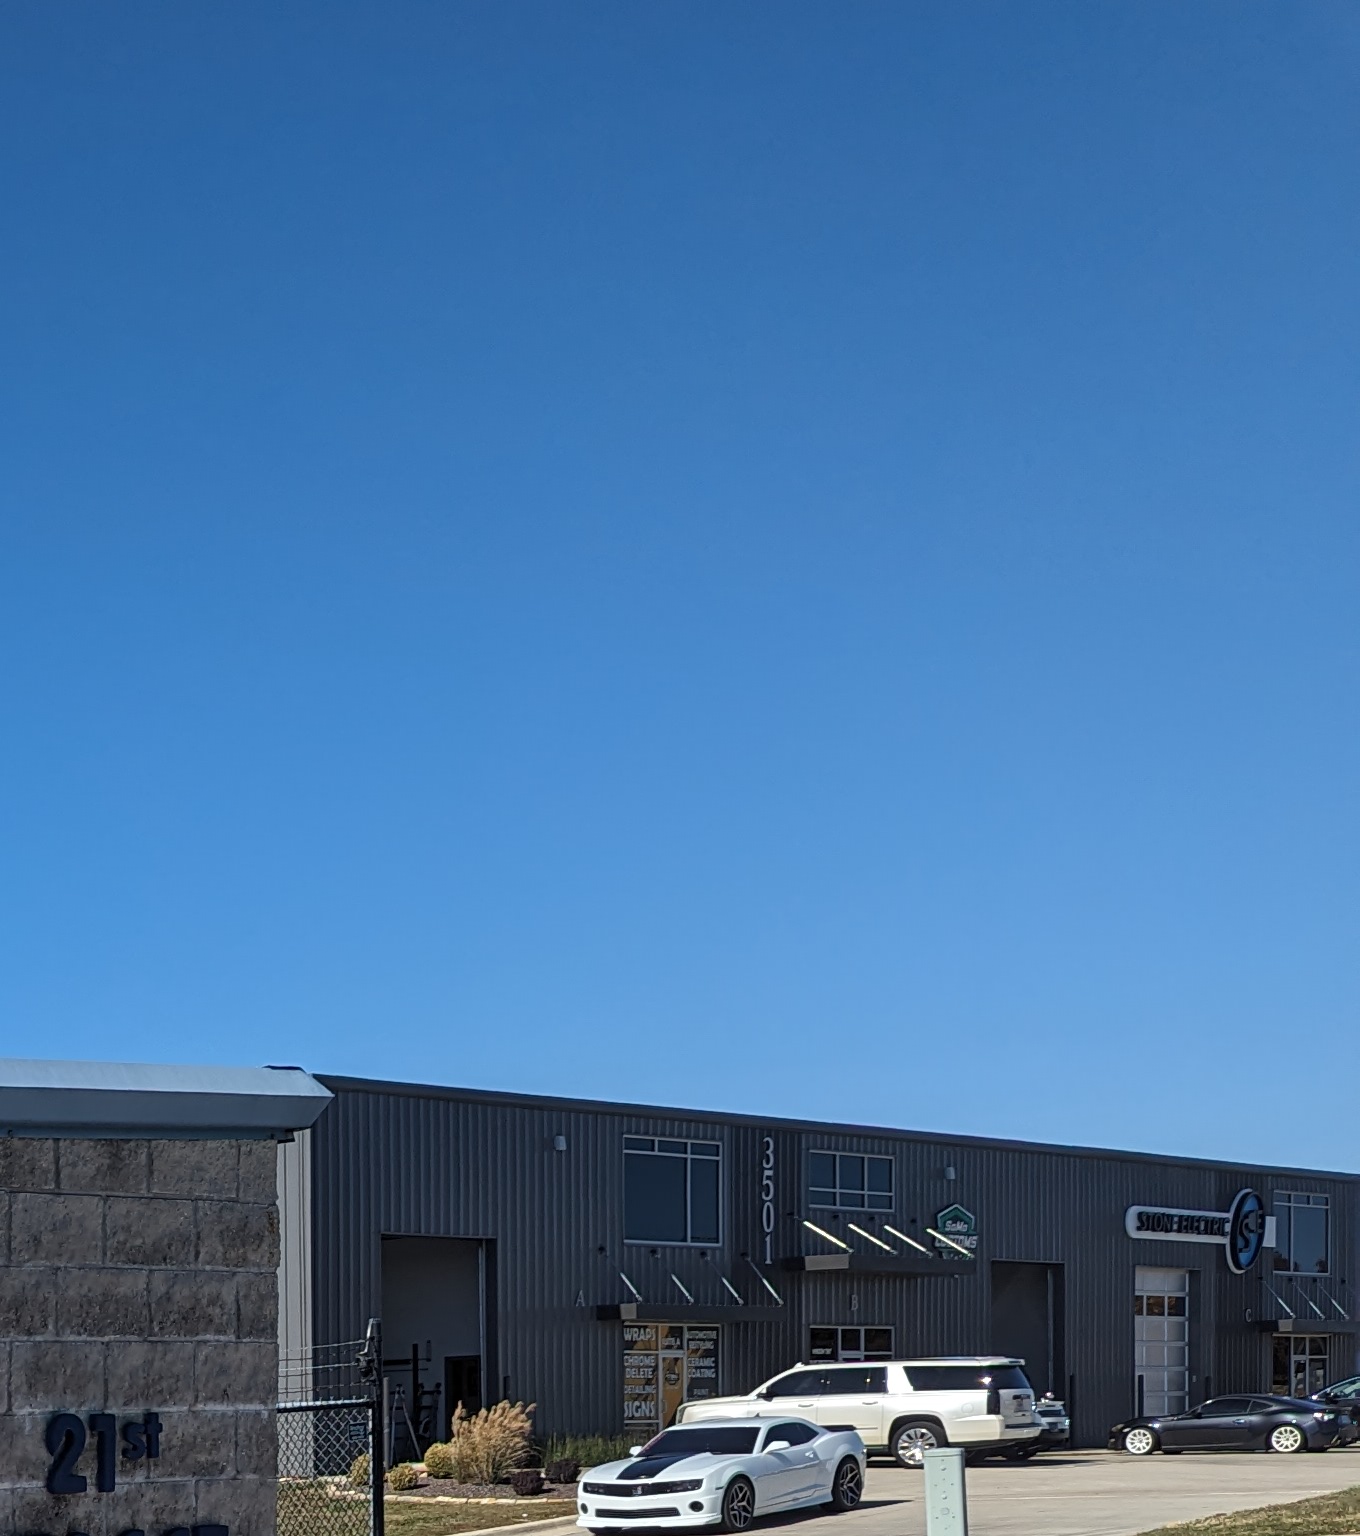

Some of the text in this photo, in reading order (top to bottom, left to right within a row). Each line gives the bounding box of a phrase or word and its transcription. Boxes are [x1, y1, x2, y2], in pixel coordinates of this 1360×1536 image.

[761, 1137, 774, 1265] 3501
[1180, 1214, 1230, 1236] ELECTRIC
[575, 1289, 585, 1307] A
[850, 1294, 859, 1311] B
[1245, 1308, 1252, 1322] C
[624, 1327, 656, 1341] WRAPS
[624, 1355, 656, 1366] CHROME
[687, 1357, 716, 1366] CERAMIC
[625, 1367, 654, 1379] DELETE
[687, 1368, 717, 1378] COATING
[624, 1384, 657, 1394] DETAILING
[624, 1400, 655, 1418] SIGNS
[45, 1411, 163, 1494] 21st
